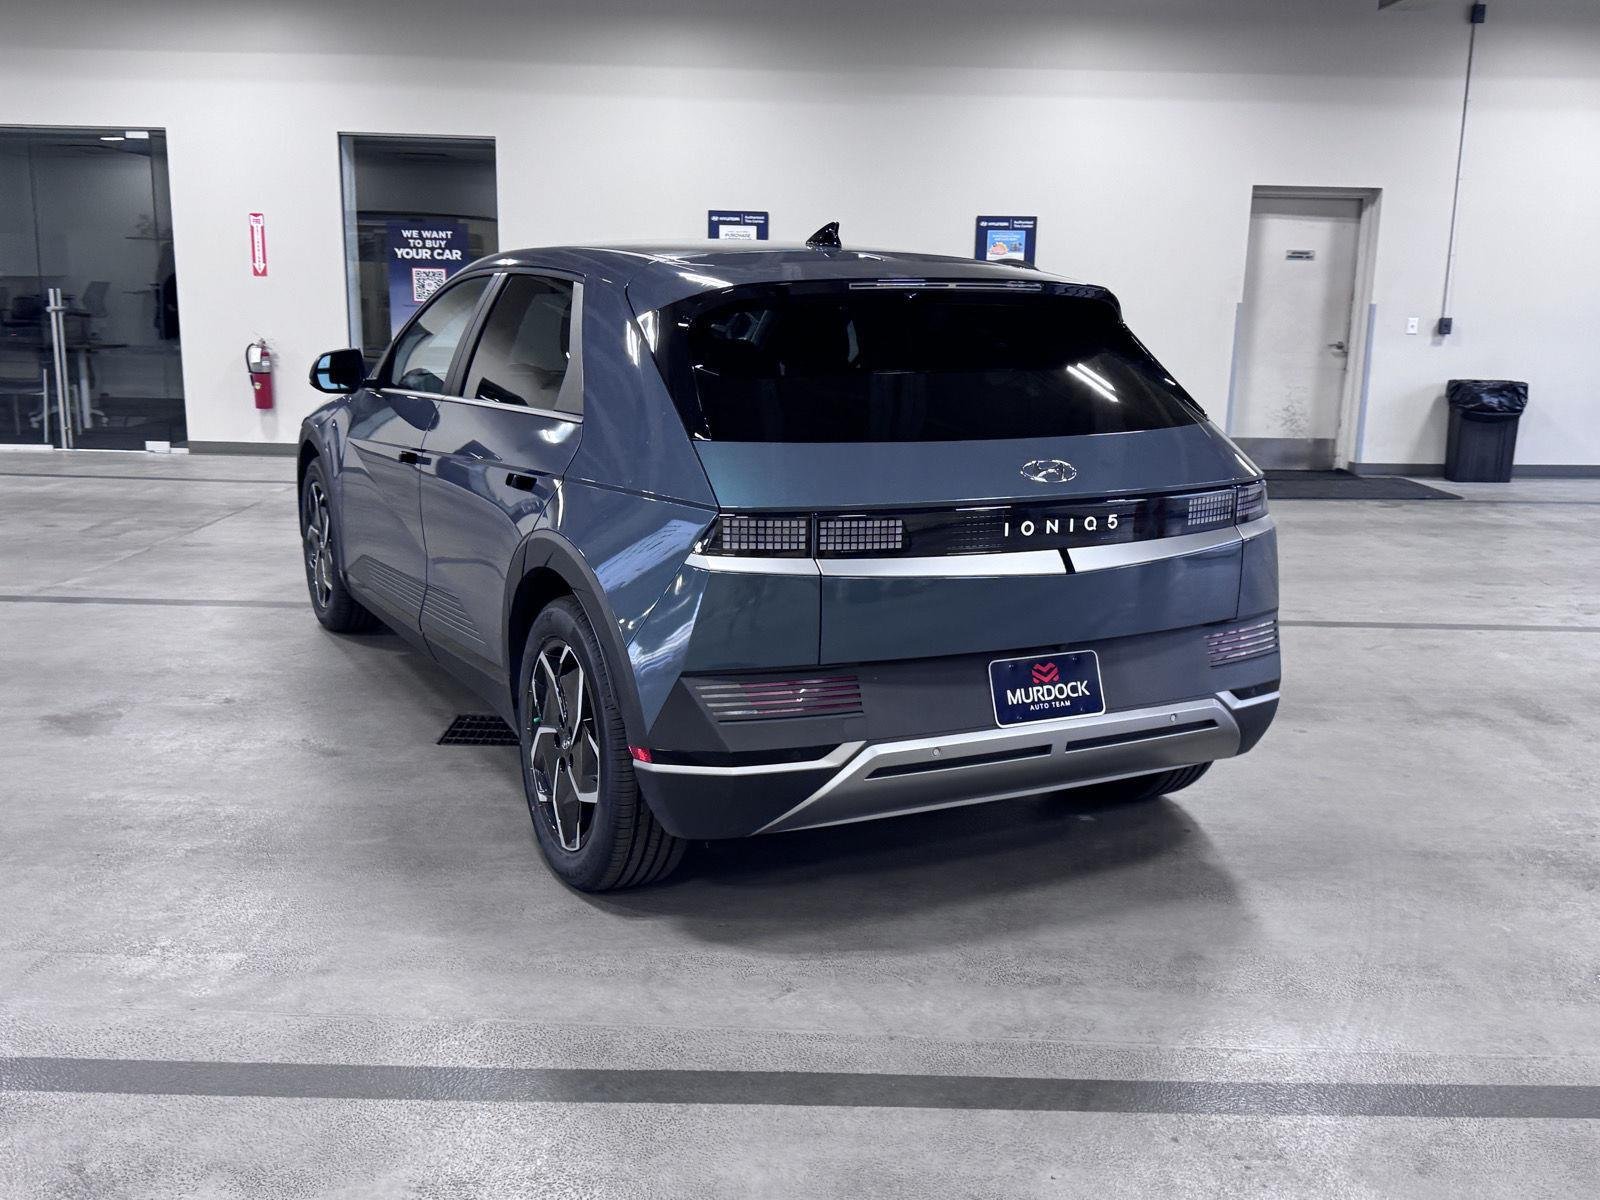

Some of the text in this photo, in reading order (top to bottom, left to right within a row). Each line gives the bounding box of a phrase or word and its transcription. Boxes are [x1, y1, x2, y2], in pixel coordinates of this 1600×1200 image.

[401, 230, 453, 238] WE WANT
[425, 240, 447, 248] BUY
[394, 248, 462, 260] YOUR CAR
[1006, 680, 1090, 705] MURDOCK
[1030, 700, 1071, 711] AUTO TEAM
